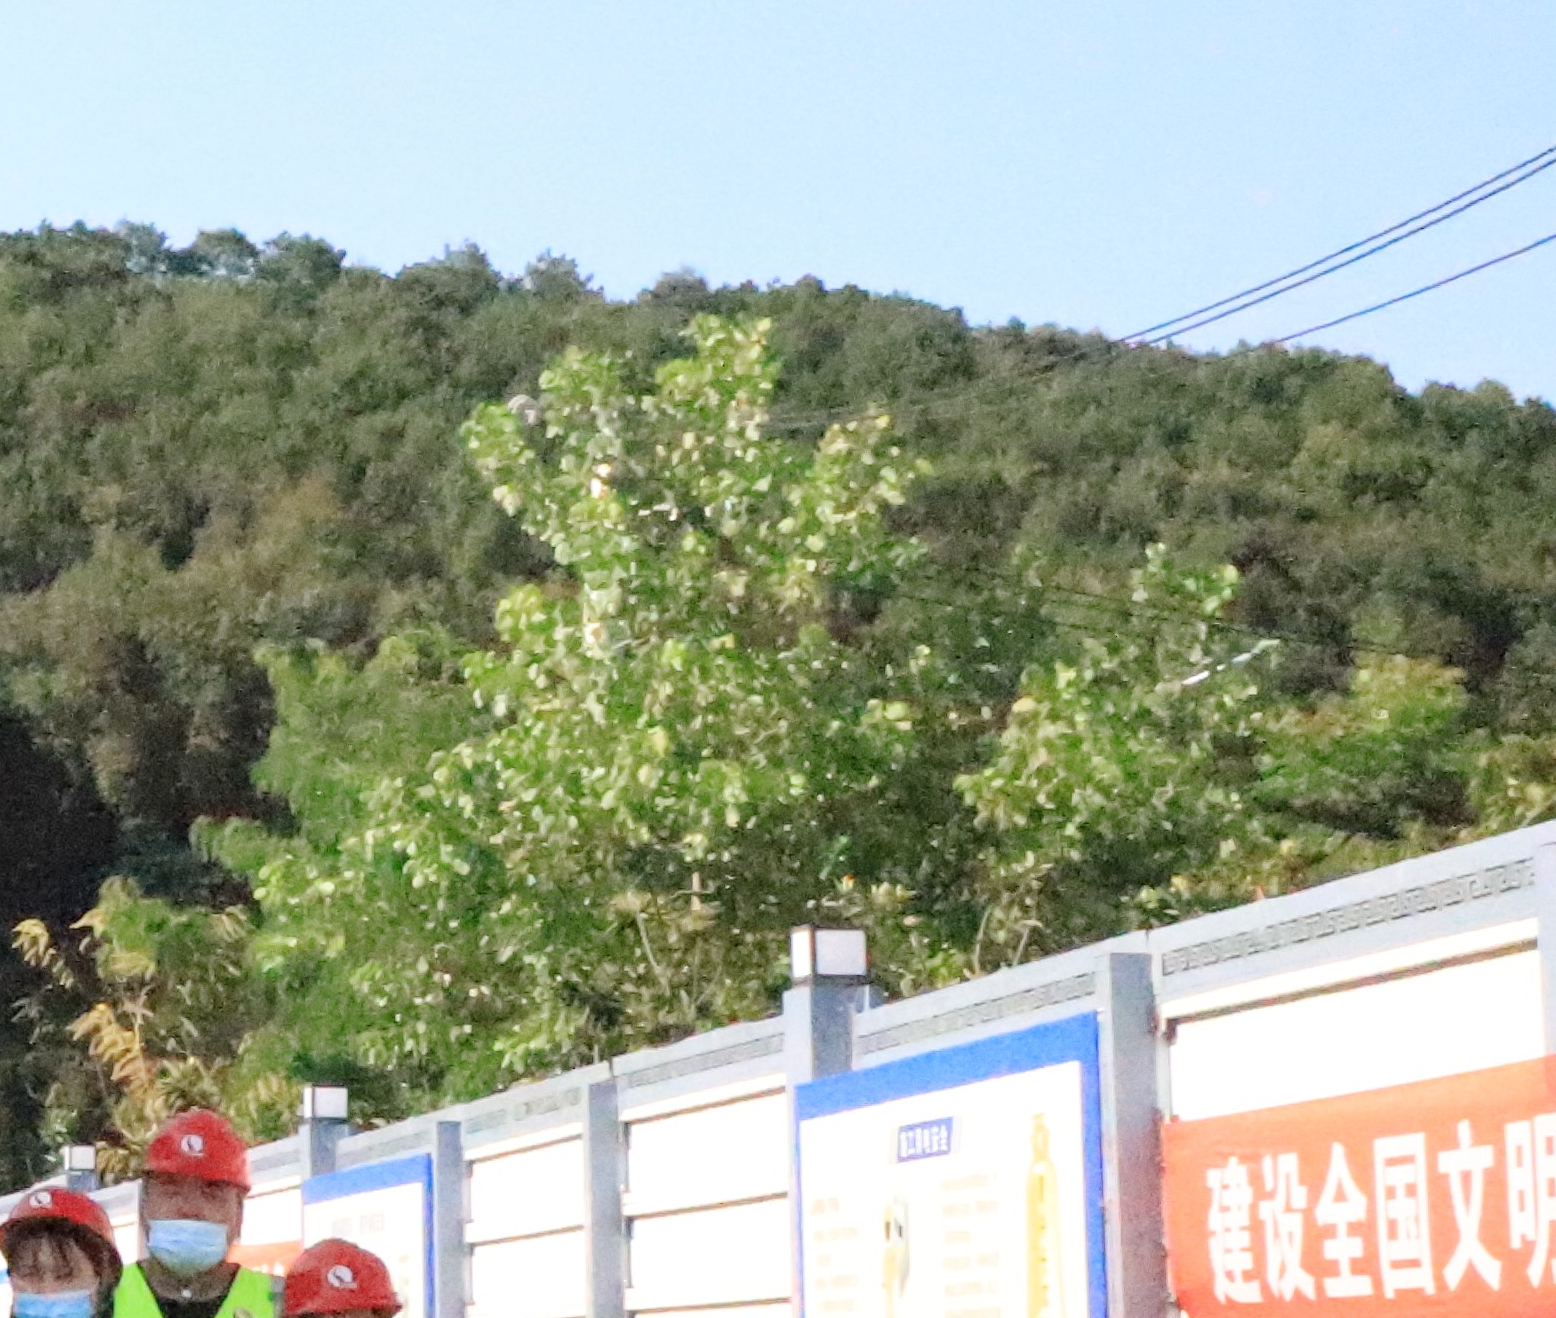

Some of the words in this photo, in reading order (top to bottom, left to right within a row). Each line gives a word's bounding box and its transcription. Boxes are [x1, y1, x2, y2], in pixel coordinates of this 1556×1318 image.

[1204, 1111, 1556, 1305] 建设全国文明
